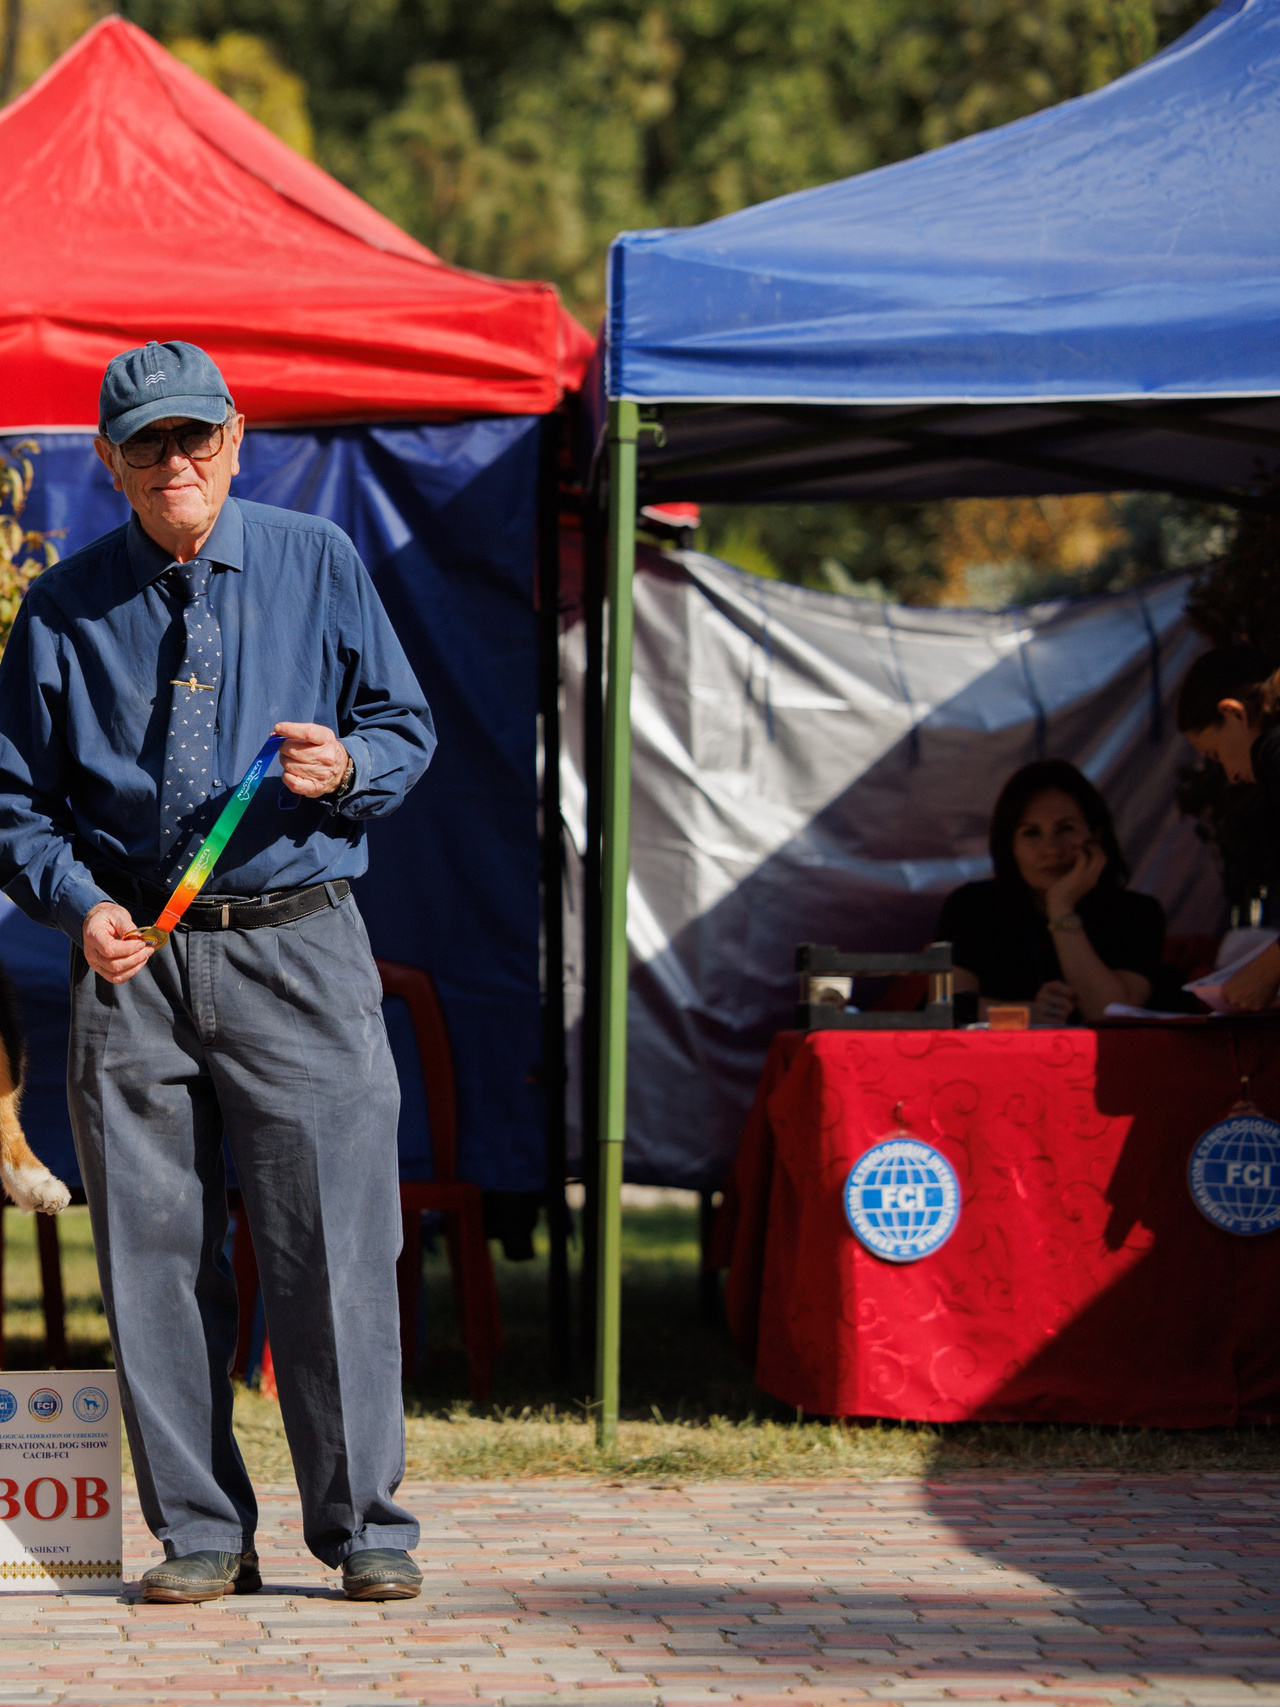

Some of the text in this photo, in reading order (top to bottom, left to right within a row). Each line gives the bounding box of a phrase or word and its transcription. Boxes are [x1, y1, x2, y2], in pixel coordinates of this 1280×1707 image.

[1227, 1164, 1271, 1187] FCI
[881, 1187, 926, 1210] FCI
[37, 1402, 54, 1410] FCI
[59, 1441, 79, 1449] DOG
[80, 1441, 109, 1449] SHOW
[22, 1451, 69, 1459] CACIB-FCI
[24, 1546, 71, 1554] TASHKENT
